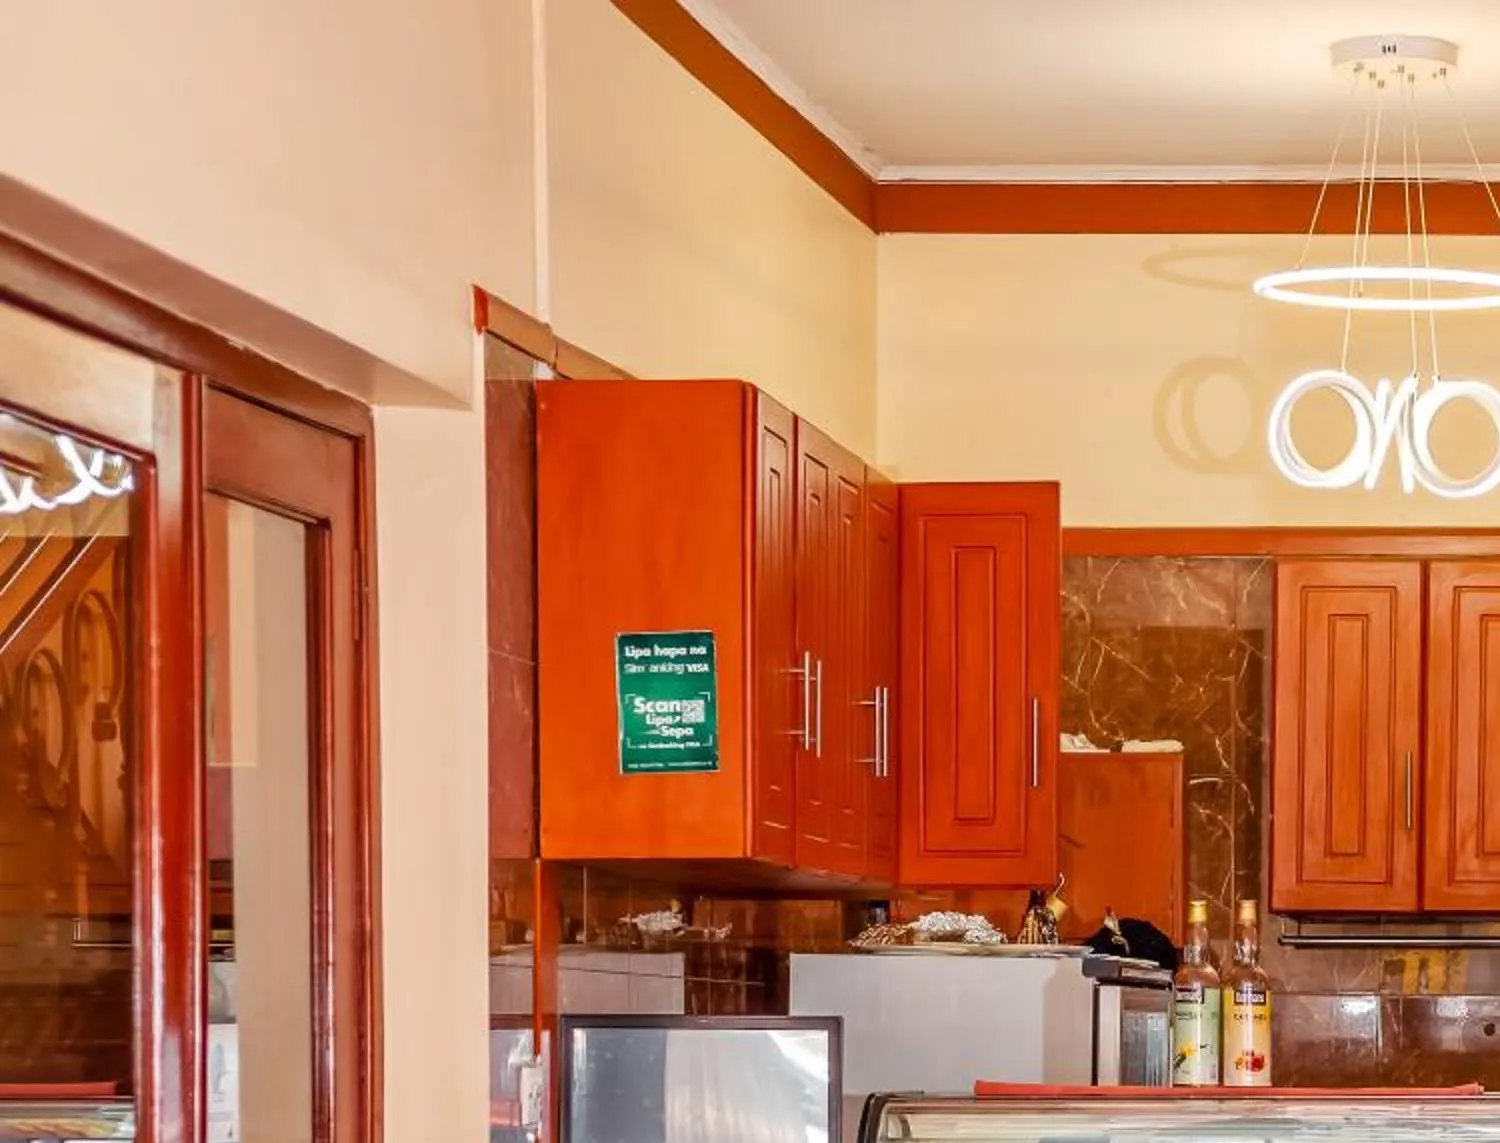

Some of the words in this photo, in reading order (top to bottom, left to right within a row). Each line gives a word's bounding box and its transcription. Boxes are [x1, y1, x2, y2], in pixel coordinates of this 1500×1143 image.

[625, 645, 652, 660] Lipa
[654, 643, 687, 660] hapa
[632, 696, 681, 714] Scan
[660, 725, 695, 739] Sepa
